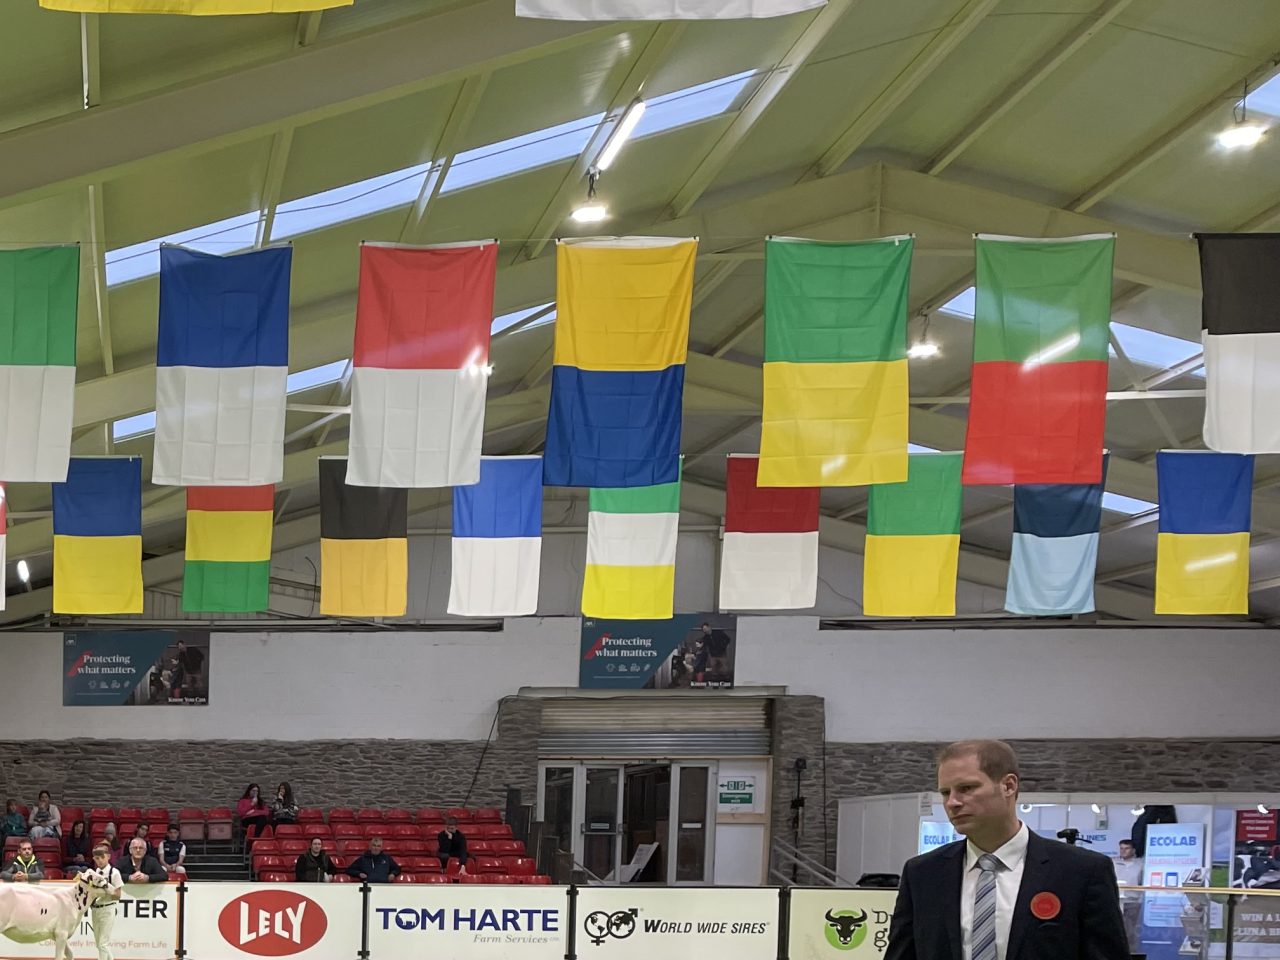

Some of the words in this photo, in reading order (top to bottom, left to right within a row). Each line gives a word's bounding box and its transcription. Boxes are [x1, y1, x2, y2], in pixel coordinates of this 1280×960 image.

[601, 637, 652, 647] Protecting
[595, 648, 619, 657] what
[620, 648, 658, 657] matters
[83, 654, 131, 664] Protecting
[77, 665, 100, 674] what
[101, 665, 136, 674] matters
[1149, 836, 1197, 847] ECOLAB
[239, 900, 308, 946] LELY
[375, 908, 445, 931] TOM
[453, 908, 559, 932] HARTE
[643, 919, 693, 933] WORLD
[697, 921, 728, 934] WIDE
[730, 921, 767, 934] SIRES
[473, 933, 502, 944] Farm
[504, 933, 549, 944] Services
[128, 939, 150, 949] Farm
[151, 940, 168, 949] Life
